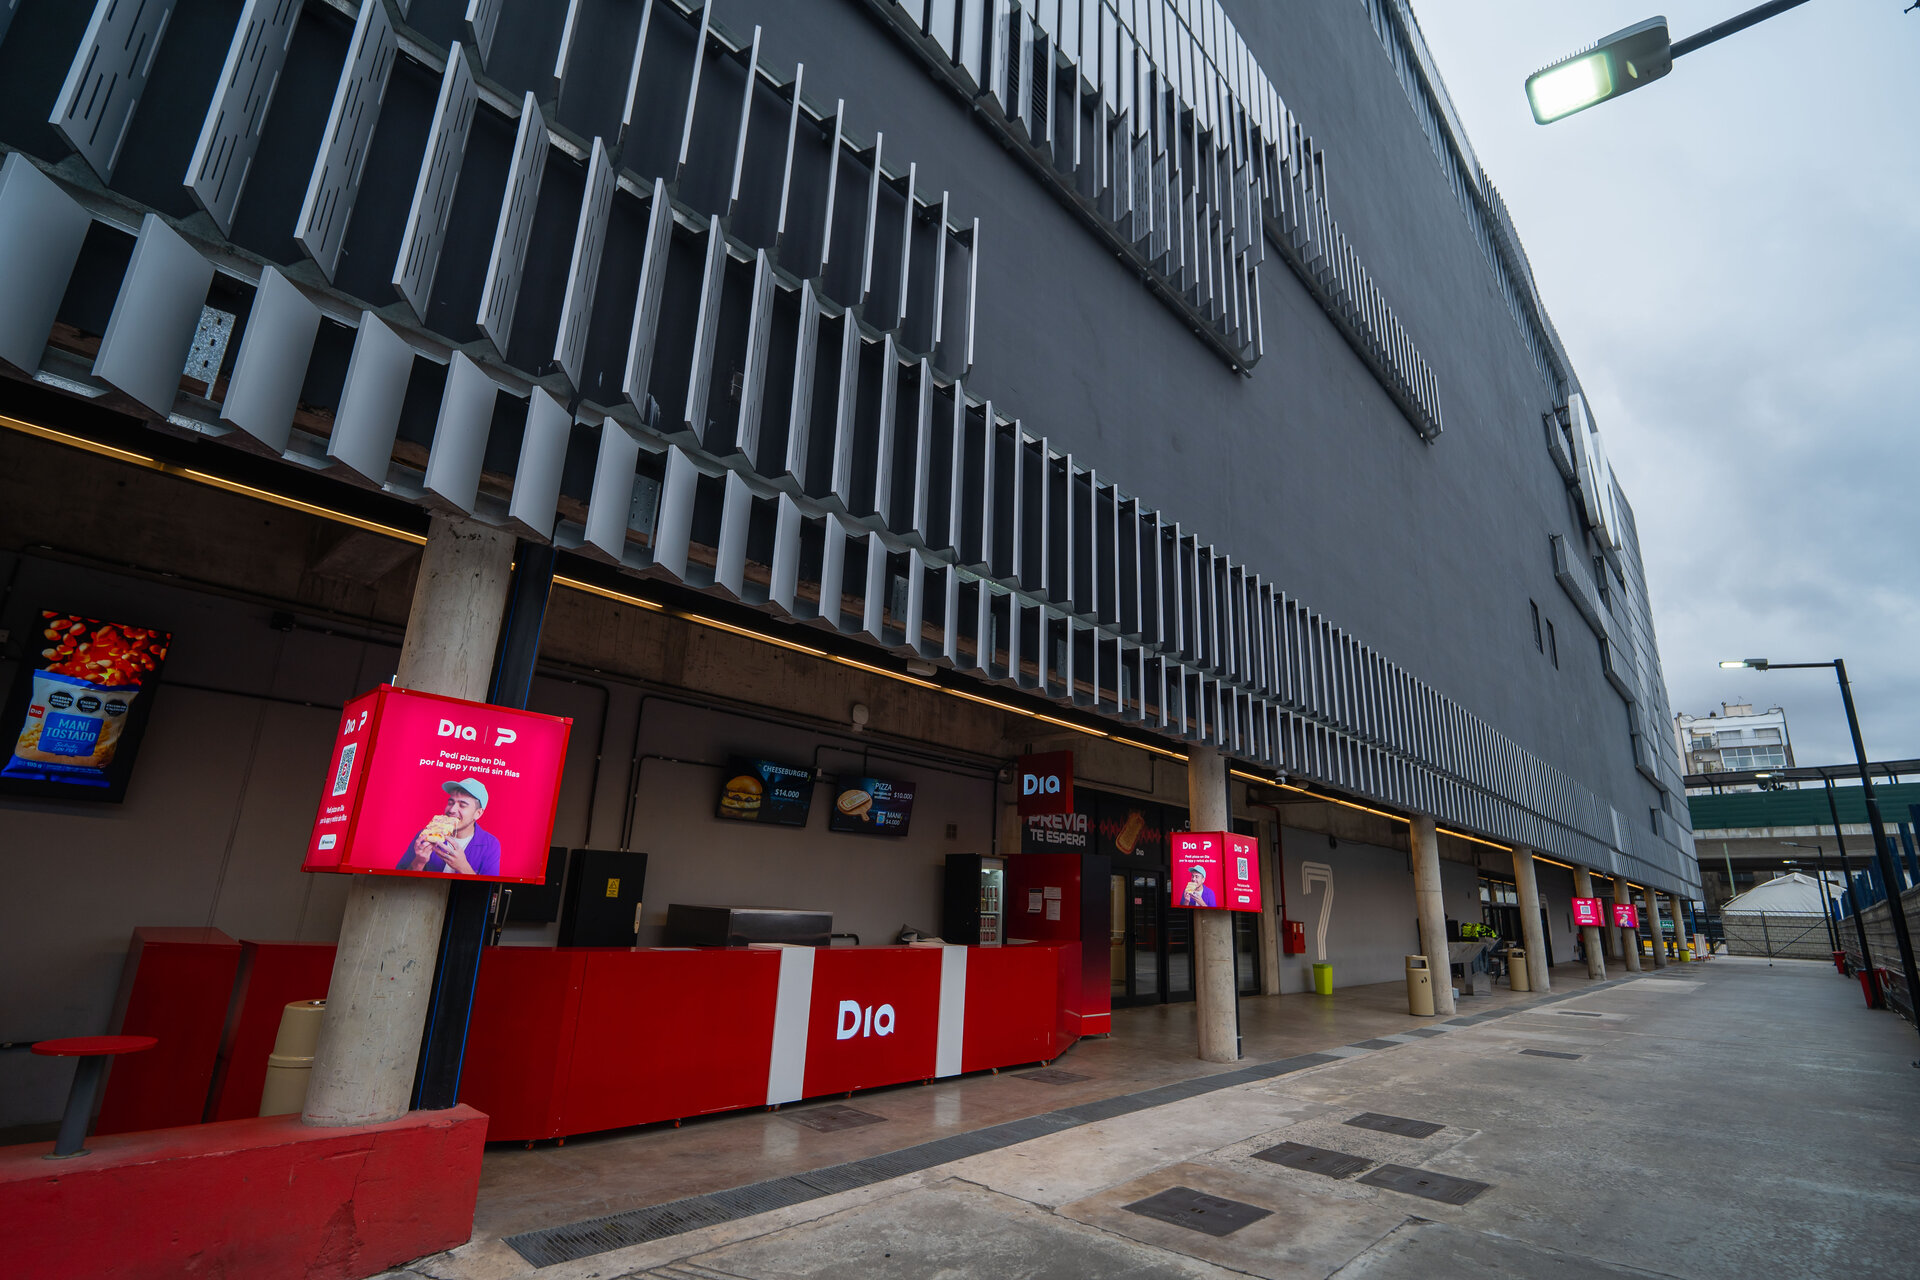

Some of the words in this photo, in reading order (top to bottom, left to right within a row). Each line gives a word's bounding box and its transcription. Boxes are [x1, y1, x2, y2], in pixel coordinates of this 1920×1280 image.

[46, 727, 96, 742] TOSTADO
[460, 754, 480, 763] pizza
[446, 762, 461, 770] app
[504, 769, 520, 778] filas
[763, 765, 808, 778] CHEESEBURGER
[775, 788, 800, 798] $14.000
[875, 782, 892, 791] PIZZA
[1030, 828, 1044, 842] TE
[1046, 831, 1086, 846] ESPERA
